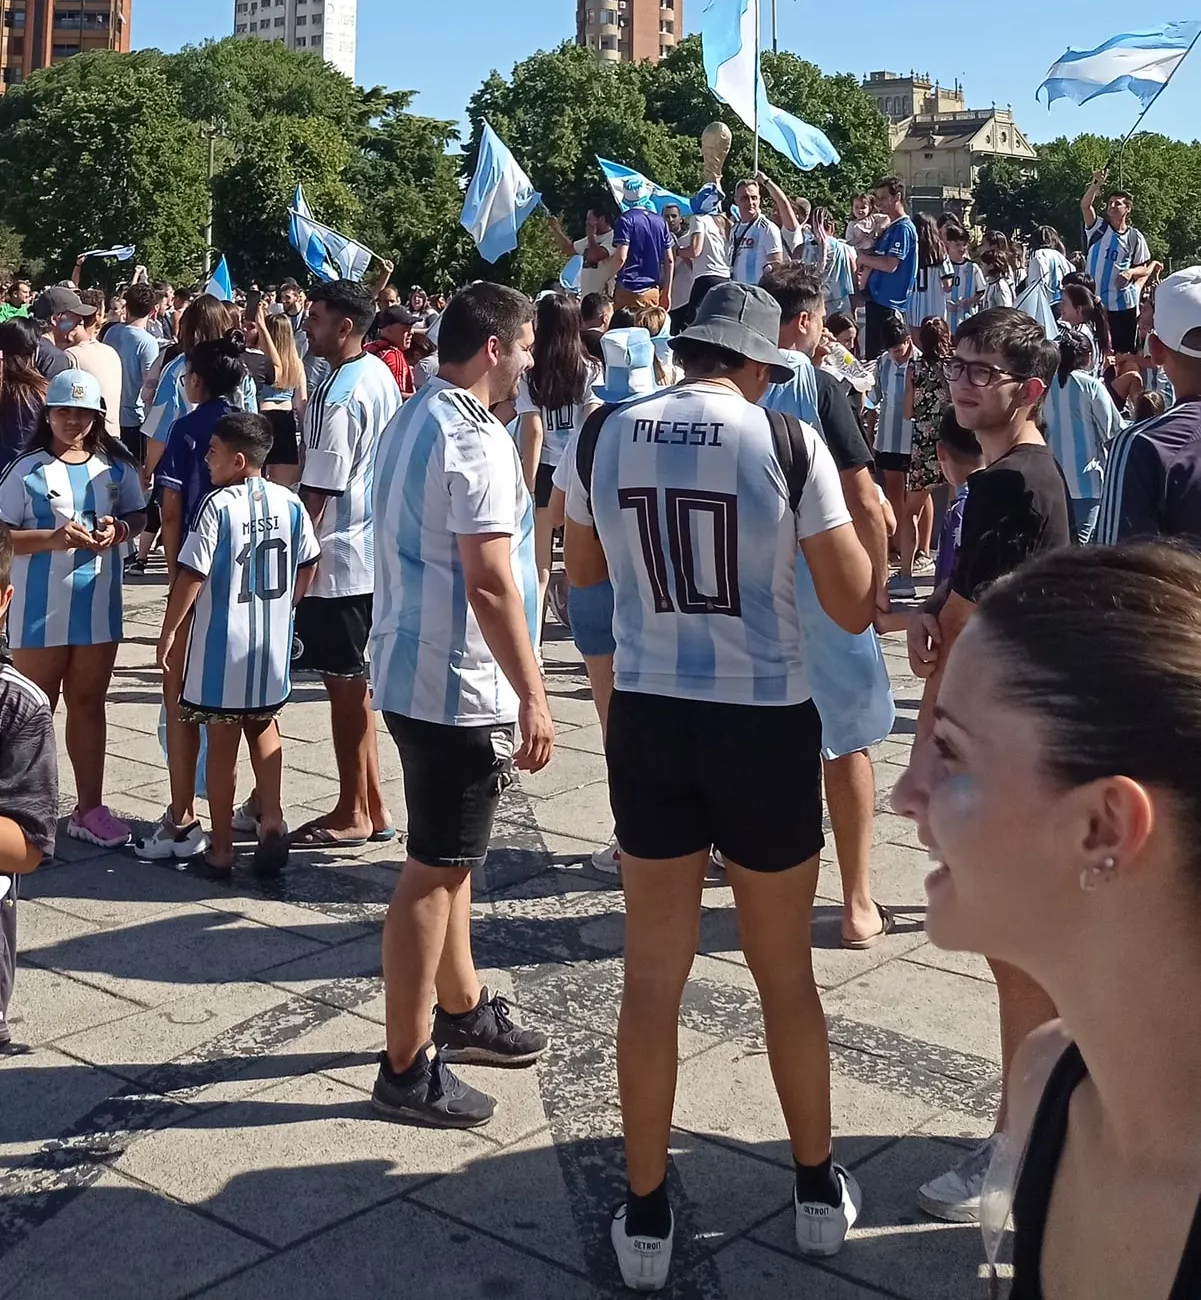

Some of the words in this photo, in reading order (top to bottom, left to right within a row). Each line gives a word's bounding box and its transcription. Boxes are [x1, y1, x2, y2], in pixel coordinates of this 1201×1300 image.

[1105, 248, 1118, 261] 10
[633, 419, 724, 447] MESSI
[242, 516, 279, 535] MESSI
[617, 487, 742, 618] 10
[235, 538, 287, 604] 10
[804, 1205, 829, 1216] DETROIT
[633, 1239, 661, 1251] DETROIT
